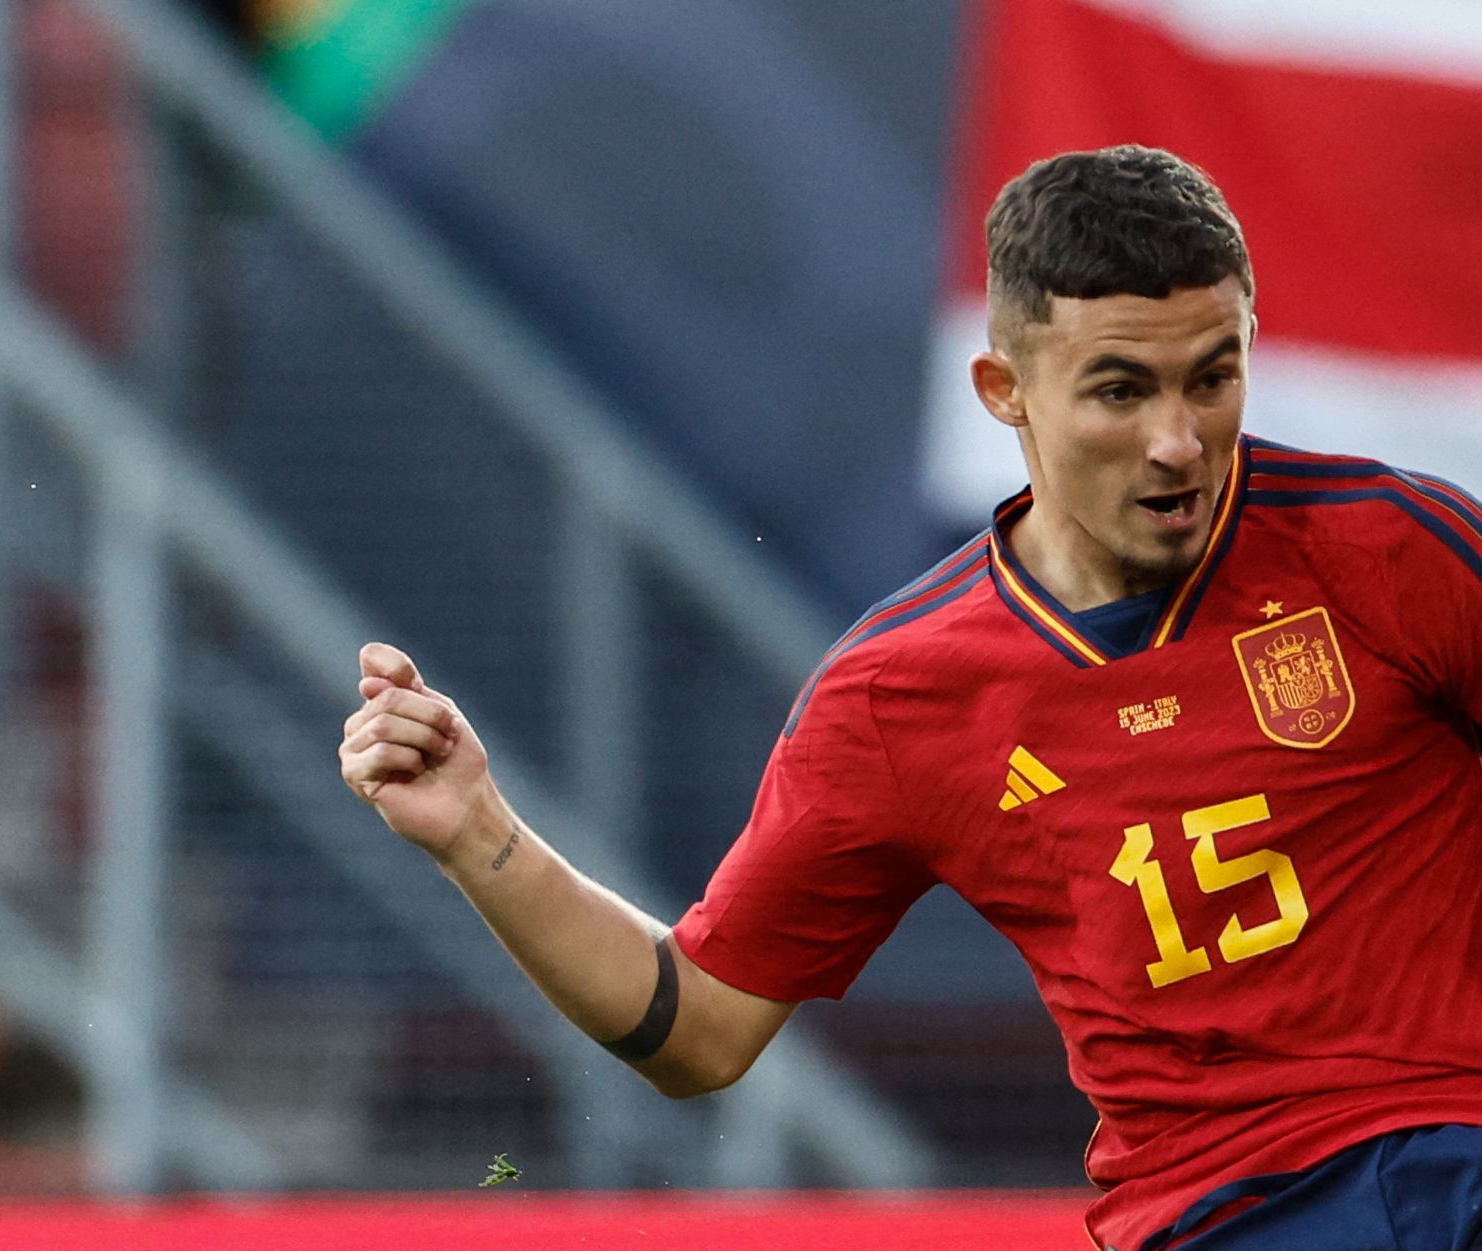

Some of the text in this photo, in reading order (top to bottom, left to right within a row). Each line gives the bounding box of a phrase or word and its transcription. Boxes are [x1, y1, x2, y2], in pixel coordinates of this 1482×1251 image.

[1117, 703, 1145, 719] SPAIN
[1153, 695, 1178, 710] ITALY
[1119, 704, 1181, 729] 15 JUNE 2023
[1129, 716, 1175, 736] ENSCHEDE
[1109, 794, 1309, 988] 15
